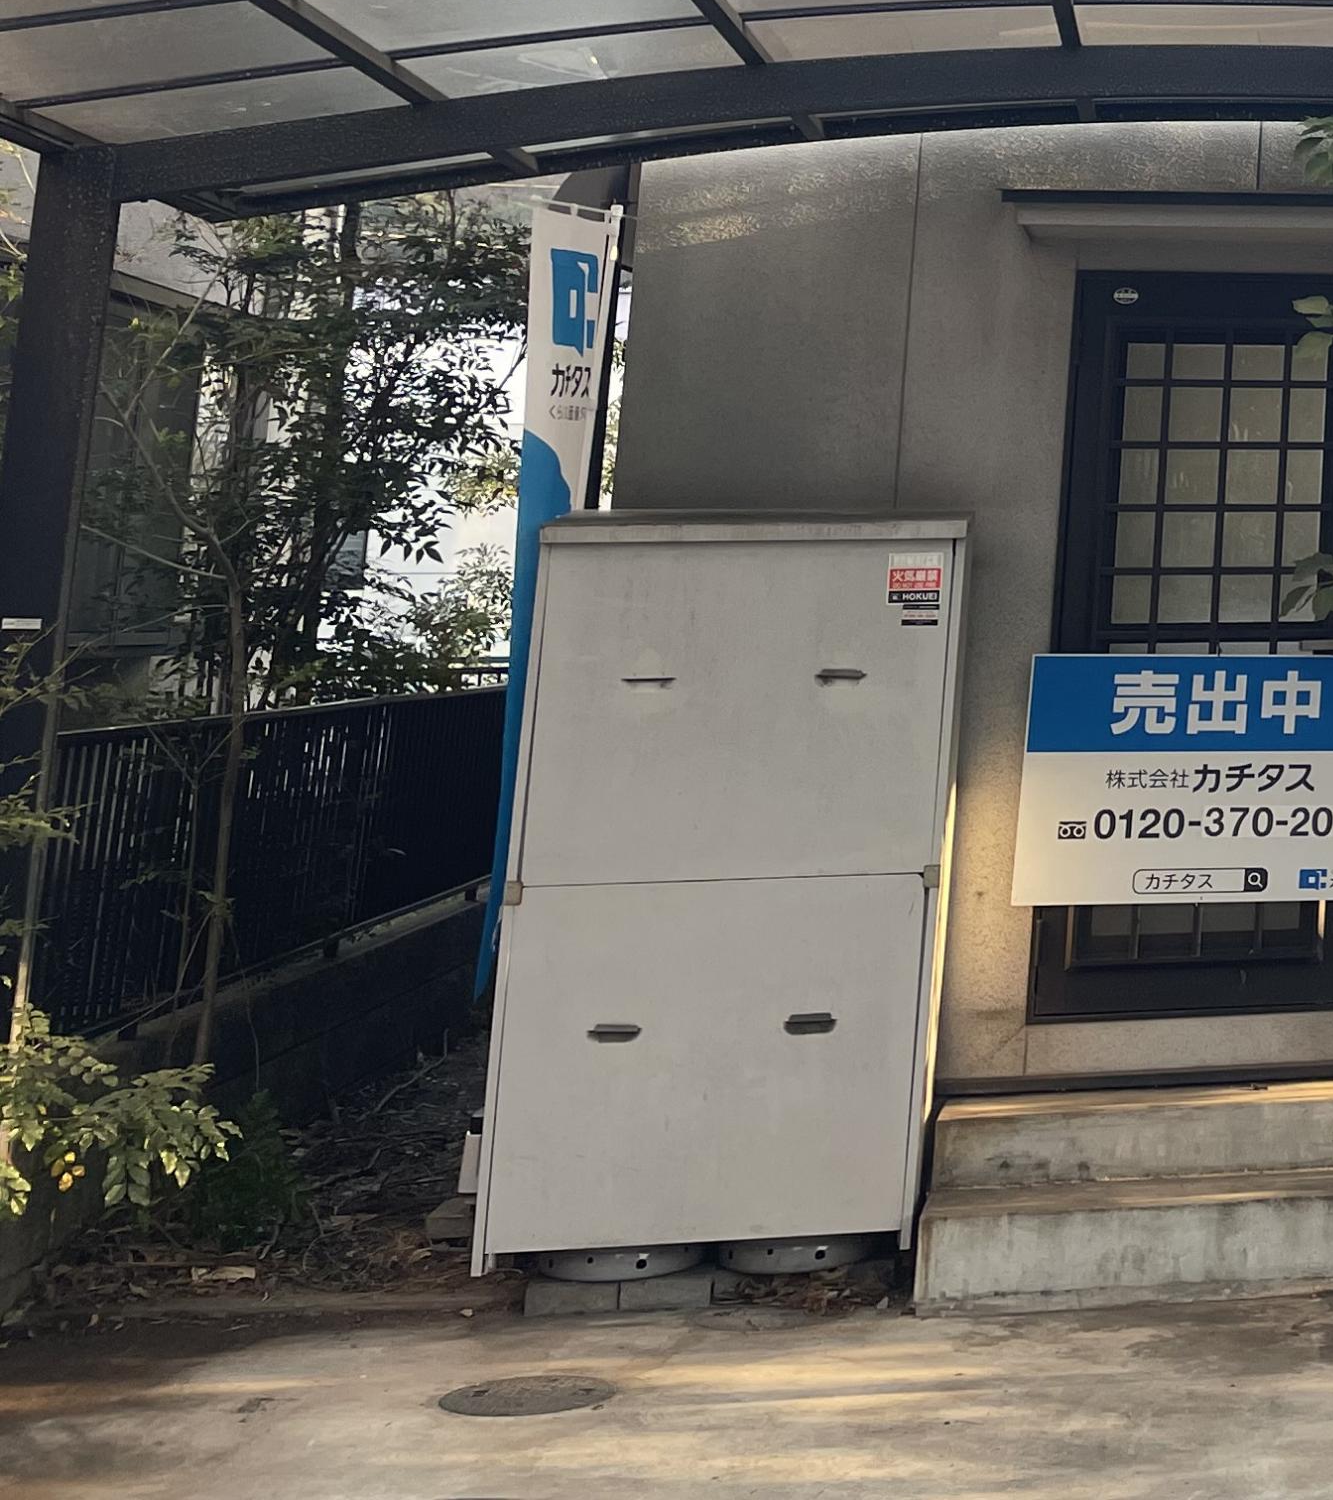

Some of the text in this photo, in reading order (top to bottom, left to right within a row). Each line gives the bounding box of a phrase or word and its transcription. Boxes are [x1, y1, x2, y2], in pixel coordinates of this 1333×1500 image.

[1110, 670, 1322, 735] 売出中
[1105, 763, 1315, 793] 株式会社カチタス
[1145, 874, 1214, 891] カチタス
